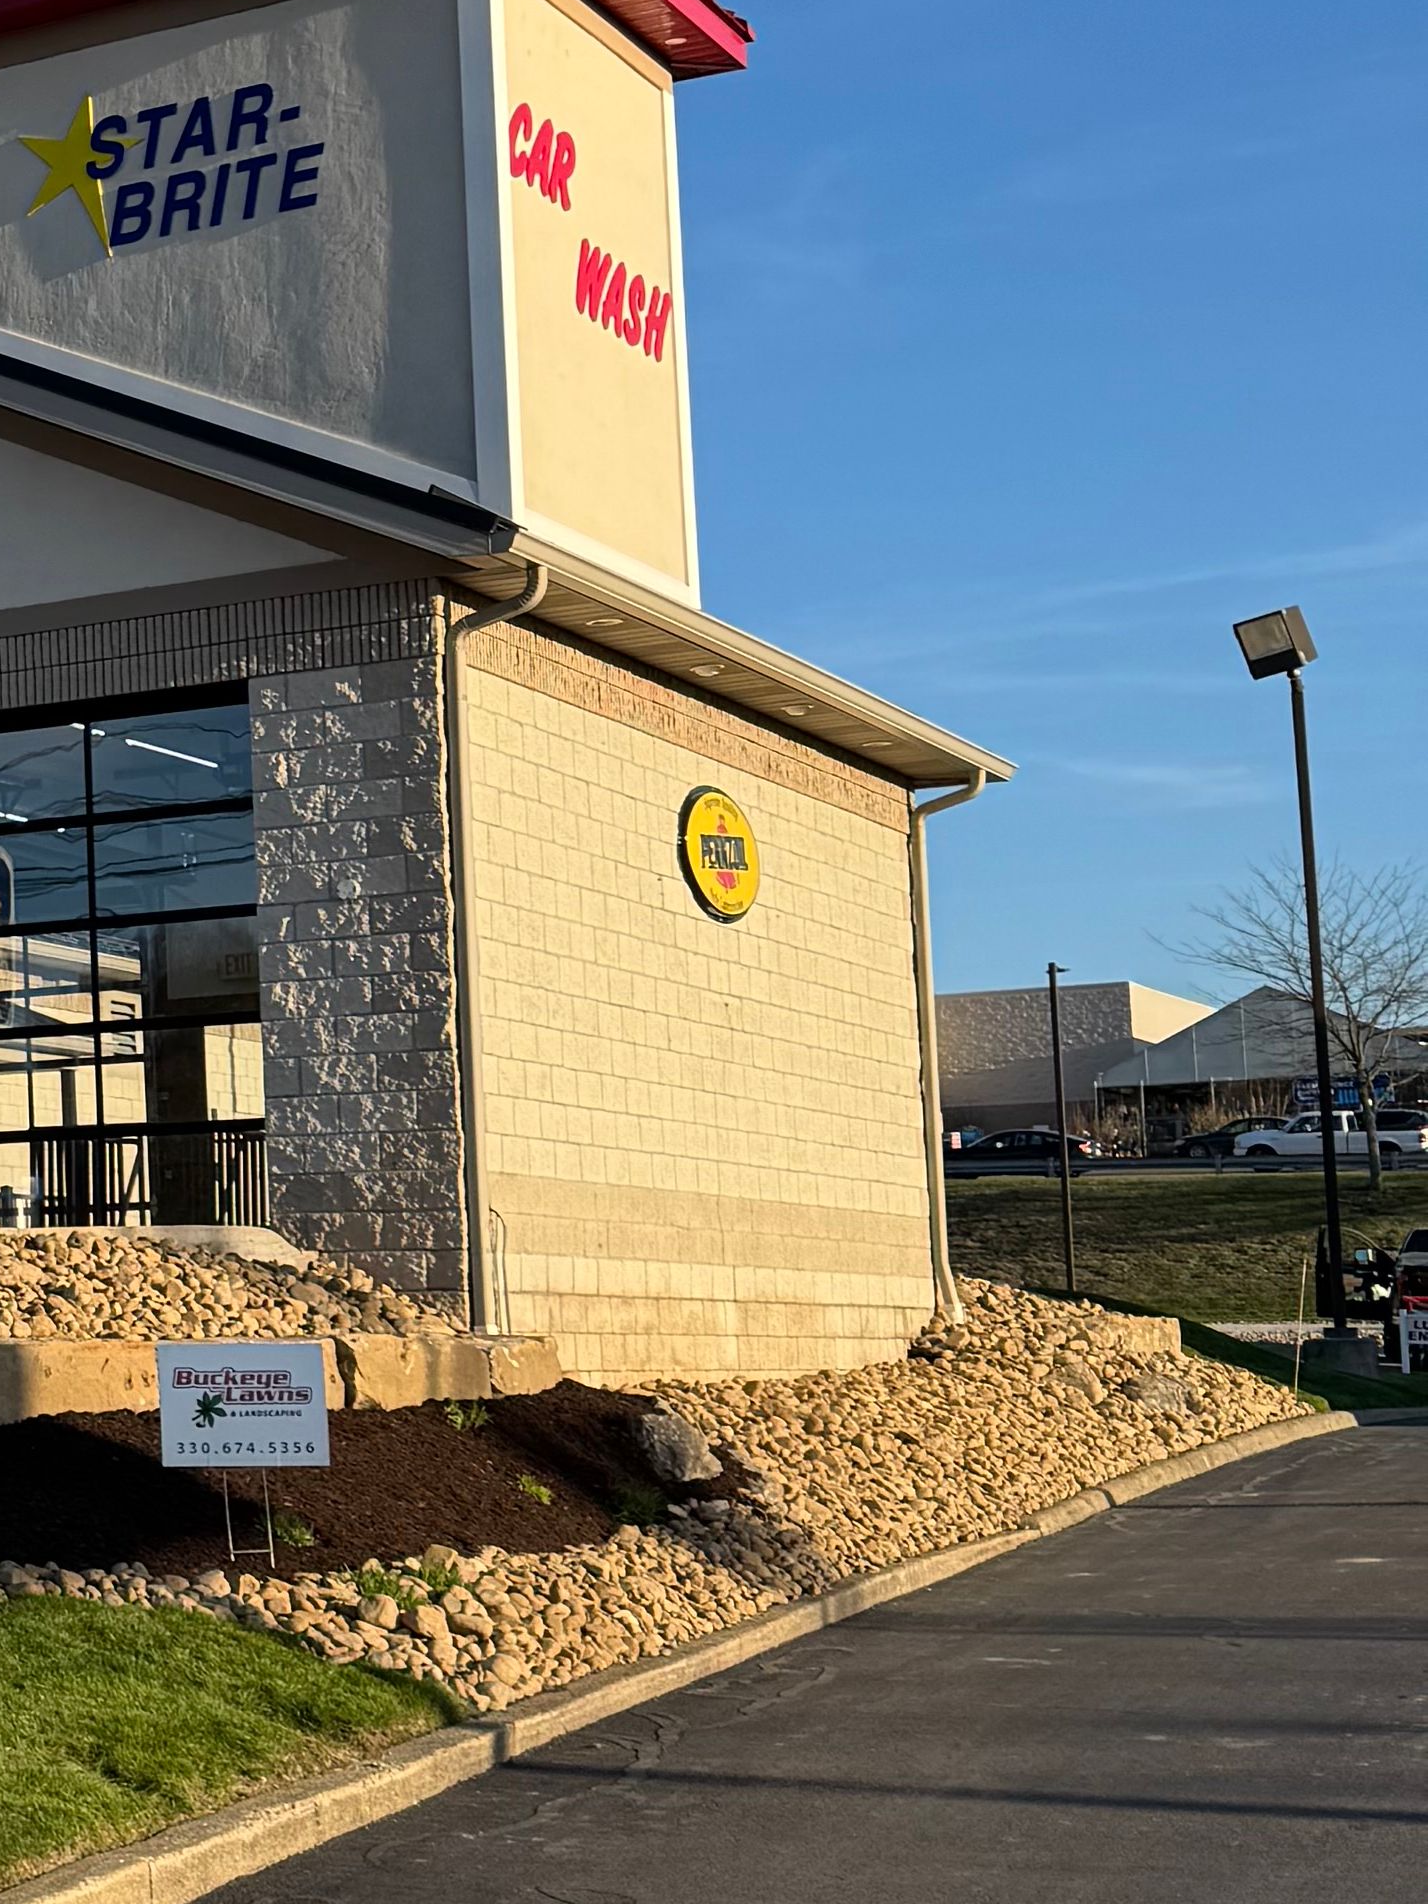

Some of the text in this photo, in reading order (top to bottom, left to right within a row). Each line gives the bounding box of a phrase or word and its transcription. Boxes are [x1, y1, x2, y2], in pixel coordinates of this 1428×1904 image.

[86, 82, 302, 179] STAR-
[508, 101, 577, 212] CAR
[109, 142, 325, 248] BRITE
[575, 239, 672, 362] WASH
[175, 1368, 290, 1389] Buckeye
[225, 1388, 311, 1403] Lawns
[177, 1441, 316, 1455] 330.674.5356
